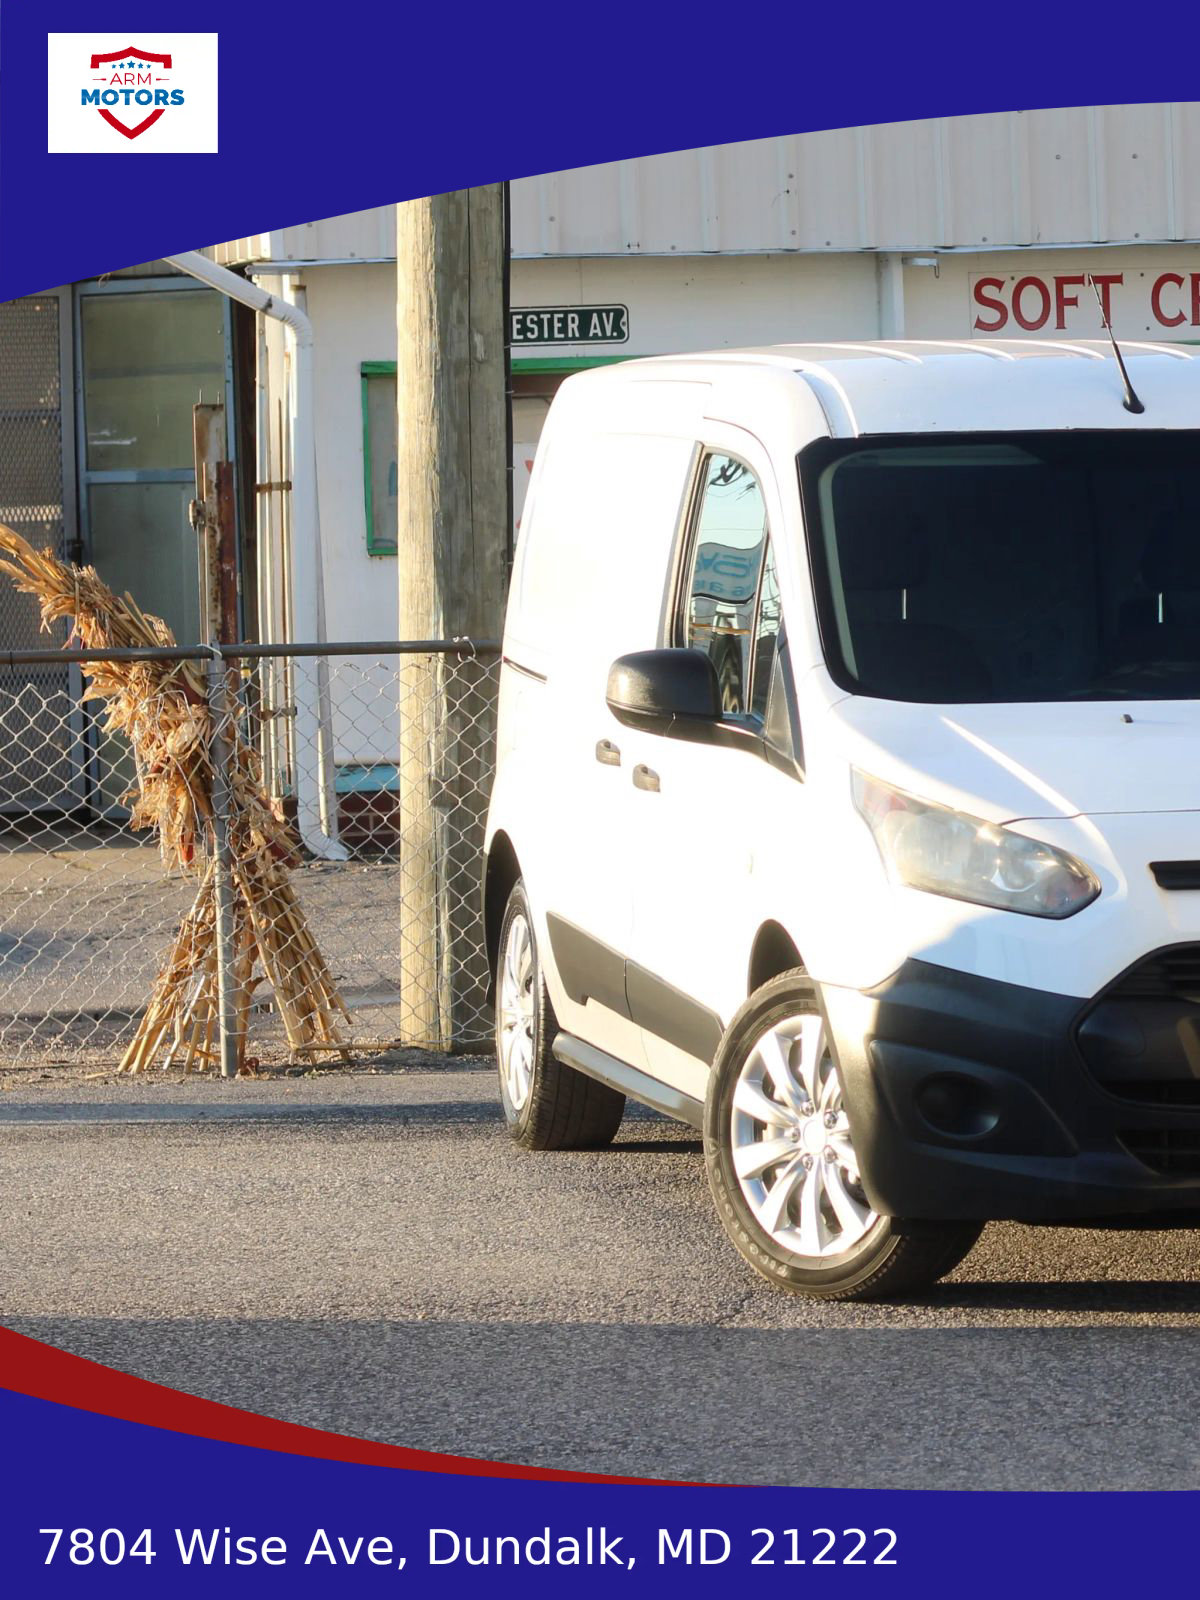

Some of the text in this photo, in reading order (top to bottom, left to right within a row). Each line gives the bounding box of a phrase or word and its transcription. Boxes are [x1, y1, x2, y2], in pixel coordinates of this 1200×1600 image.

[973, 273, 1124, 332] SOFT
[511, 312, 618, 340] ESTER AV.
